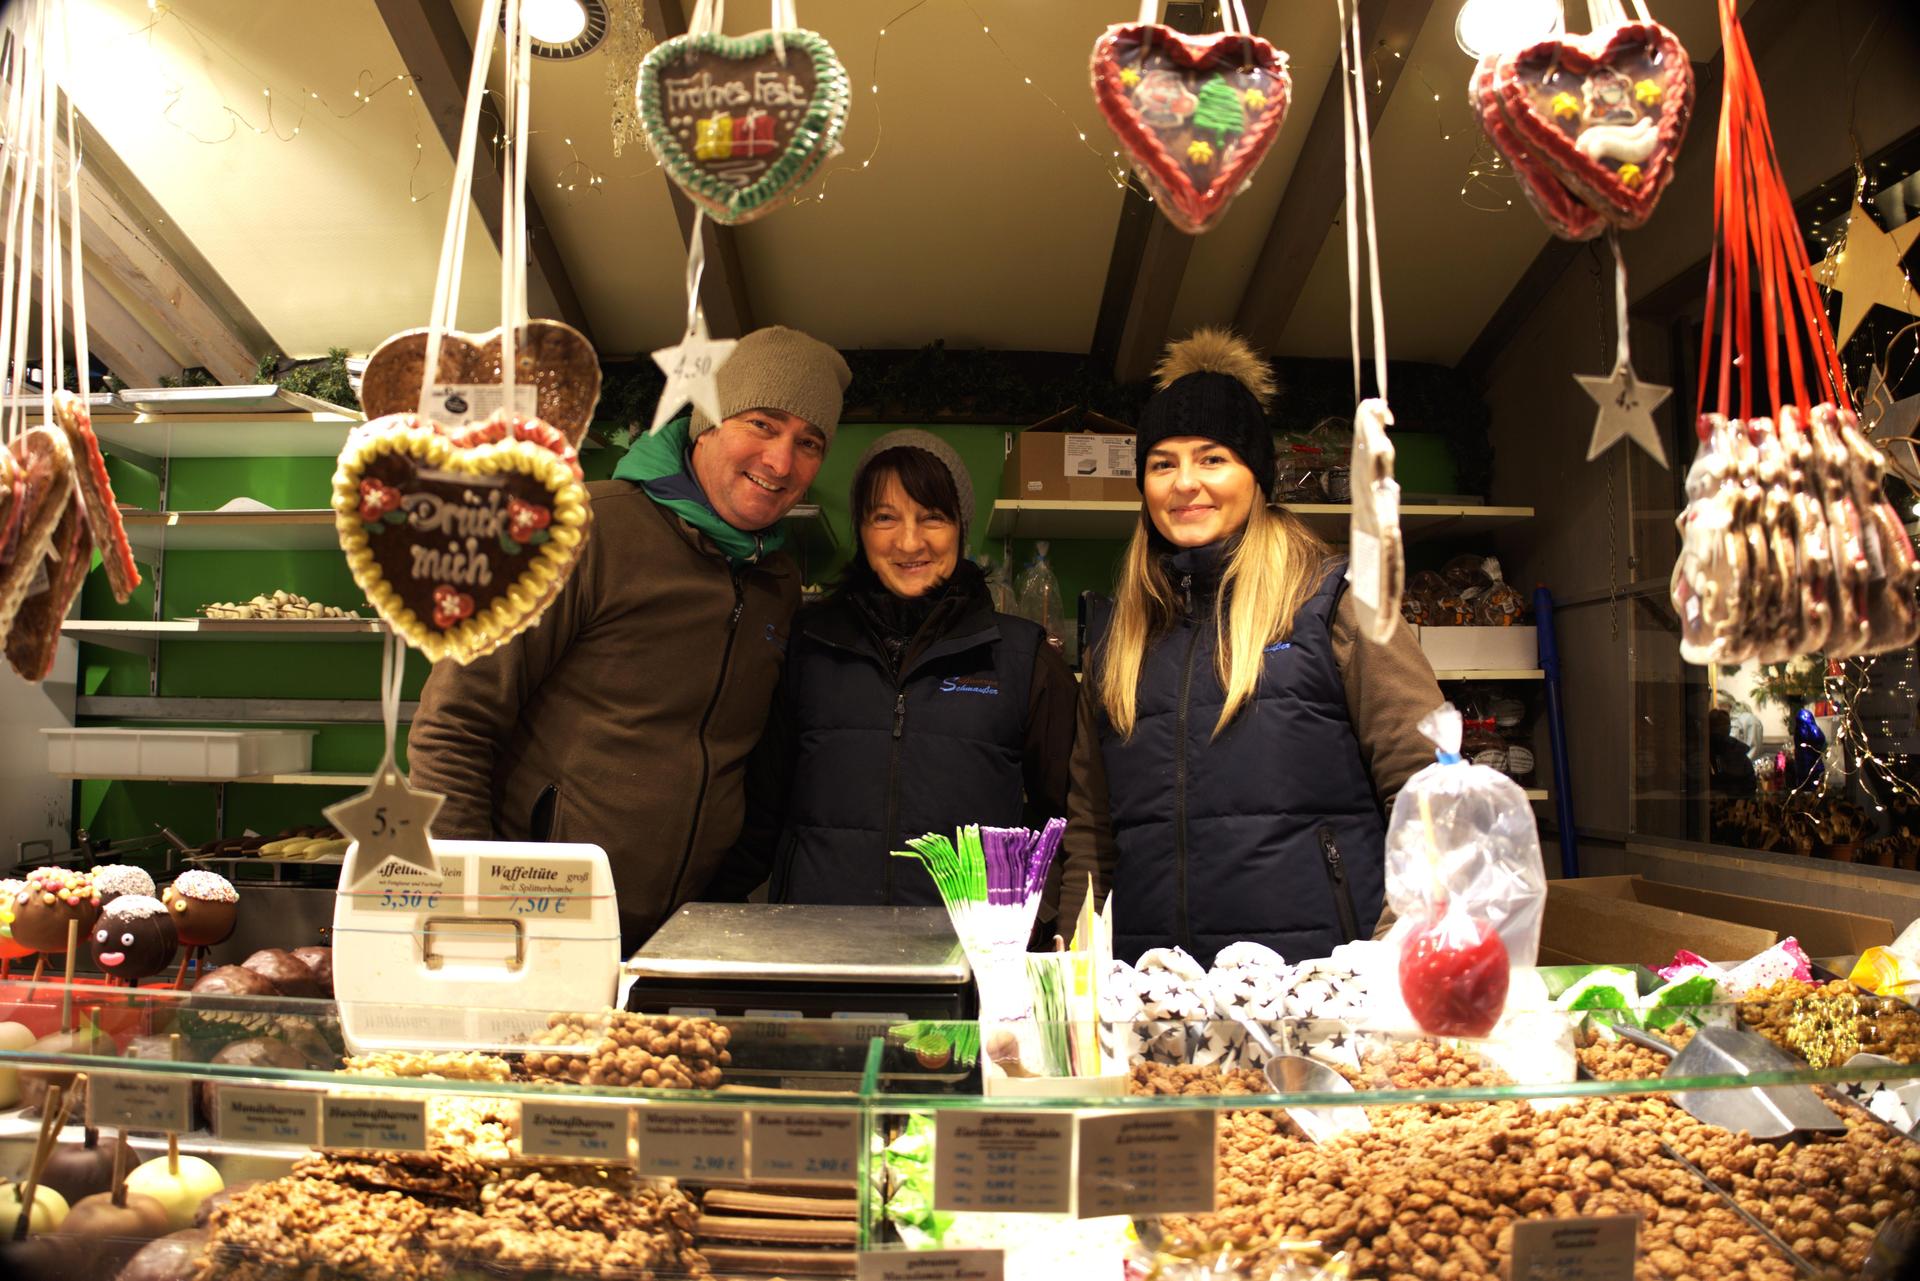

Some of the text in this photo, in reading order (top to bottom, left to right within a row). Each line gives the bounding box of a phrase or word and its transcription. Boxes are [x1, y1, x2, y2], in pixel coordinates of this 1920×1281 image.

[754, 71, 807, 106] Fest
[410, 537, 493, 586] mich
[371, 806, 410, 839] 5,-
[491, 865, 589, 883] Waffeltüte groß
[380, 888, 442, 910] 5,50 €
[554, 895, 568, 914] €
